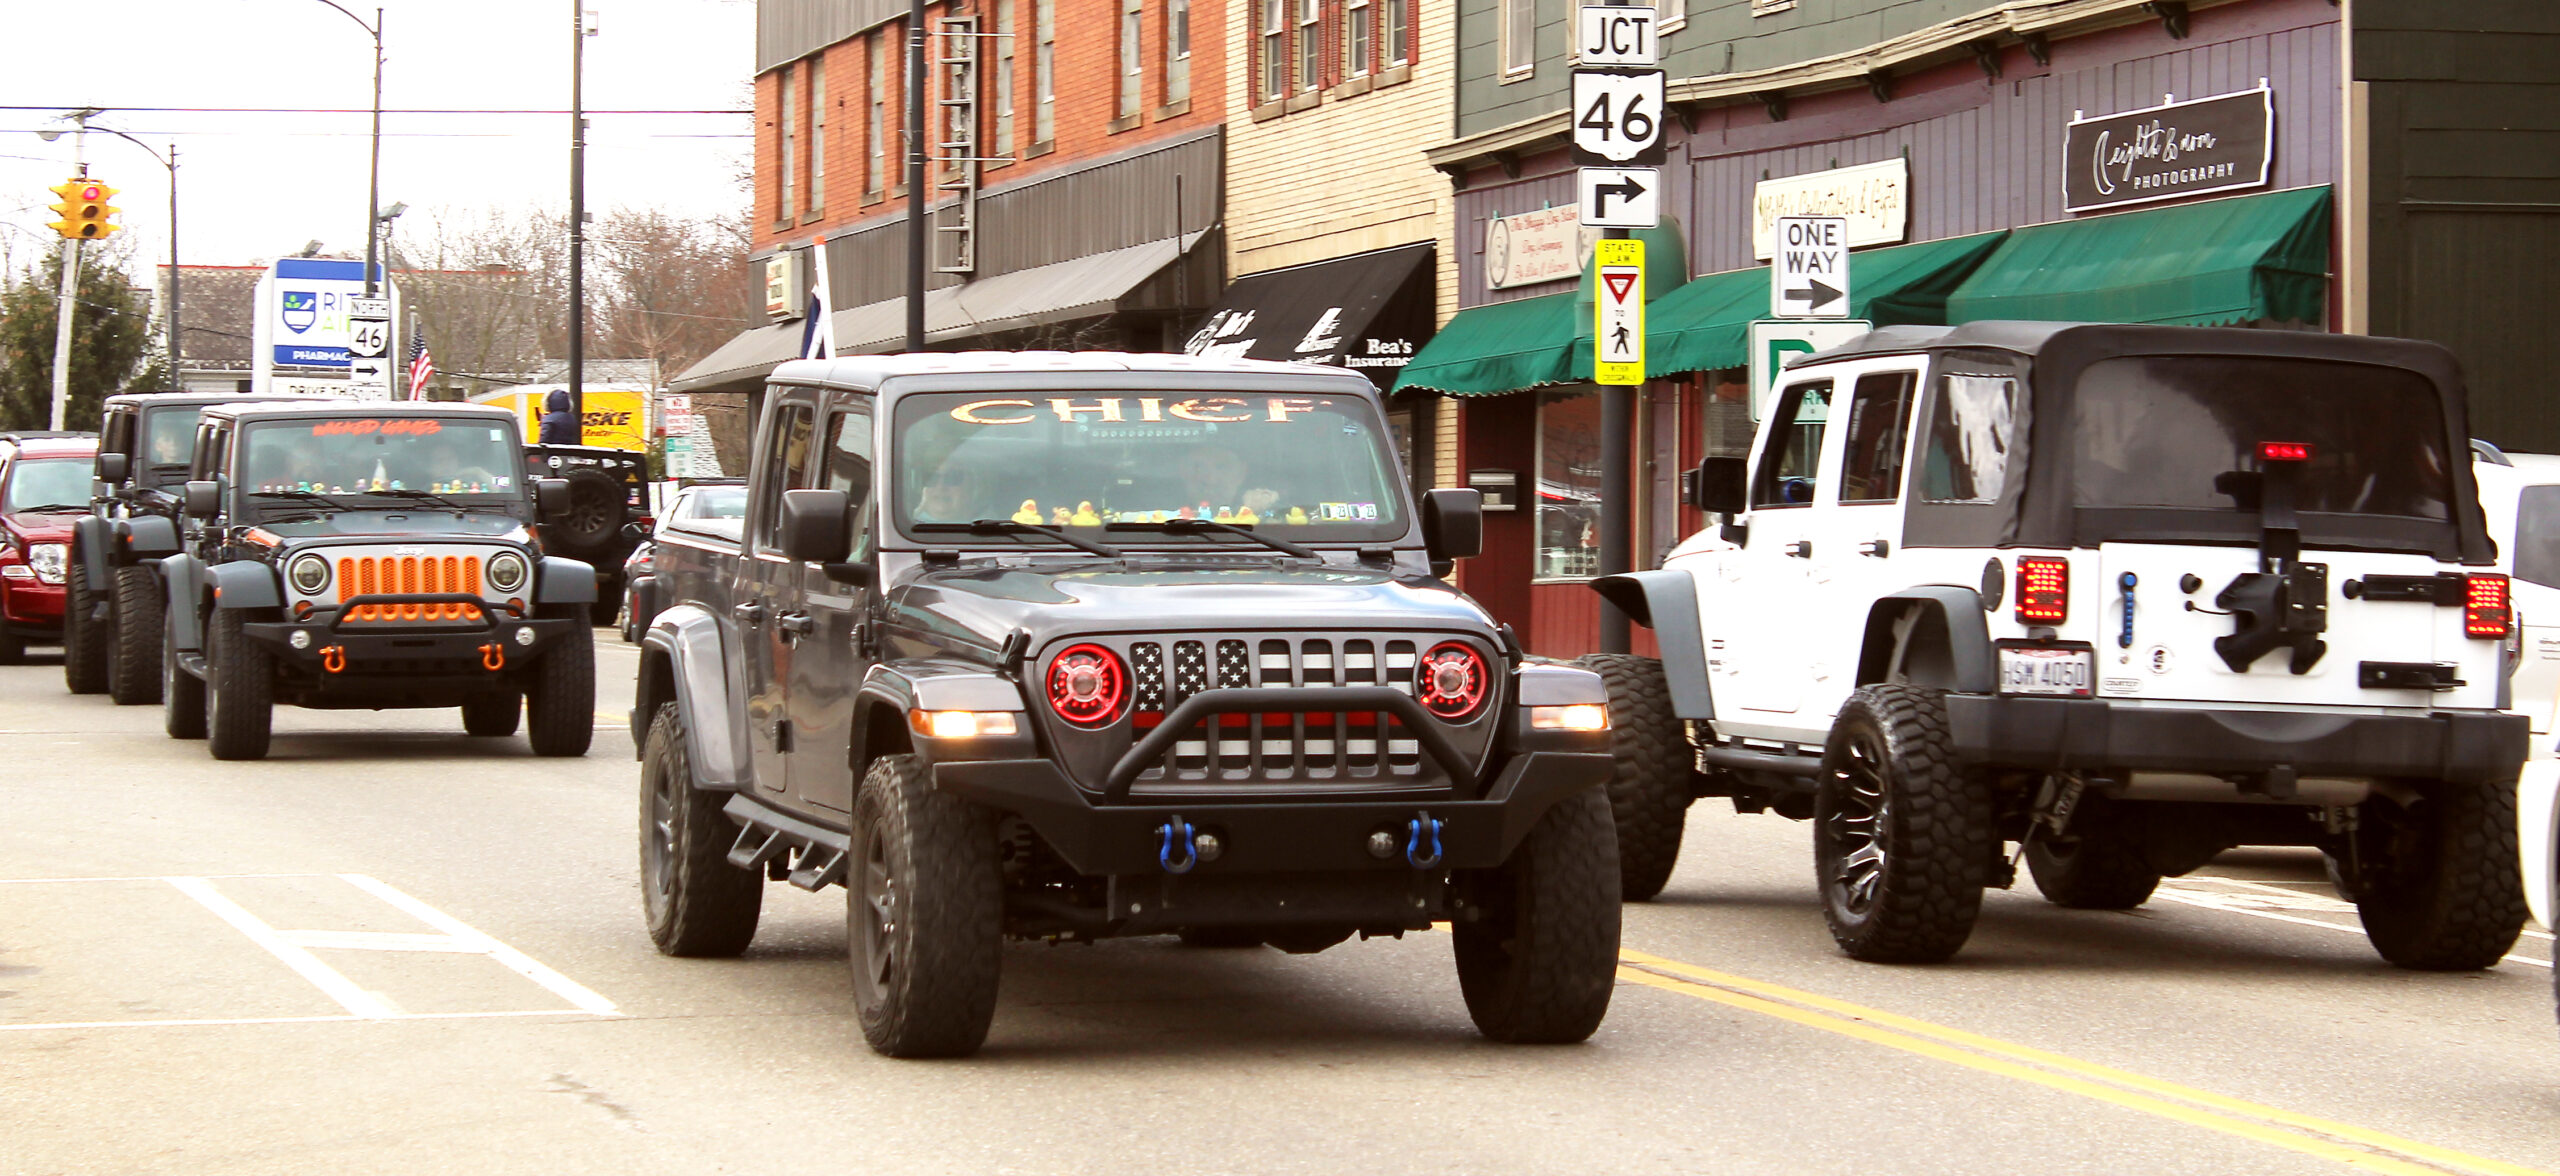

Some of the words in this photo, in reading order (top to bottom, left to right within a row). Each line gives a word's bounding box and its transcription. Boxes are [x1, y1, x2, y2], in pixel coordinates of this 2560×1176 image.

[1589, 17, 1649, 55] JCT
[1579, 92, 1653, 142] 46
[2133, 162, 2234, 190] PHOTOGRAPHY
[1788, 223, 1837, 246] ONE
[1604, 243, 1636, 253] STATE
[1609, 254, 1630, 264] LAW
[1787, 251, 1838, 273] WAY
[324, 292, 360, 311] RIT
[352, 302, 388, 314] NORTH
[322, 315, 350, 332] AI
[355, 328, 382, 348] 46
[1367, 338, 1412, 355] Bea's
[292, 350, 351, 362] PHARMAC
[1345, 354, 1414, 368] Insuranc
[950, 397, 1332, 425] CHIEF
[2040, 661, 2086, 687] 4050
